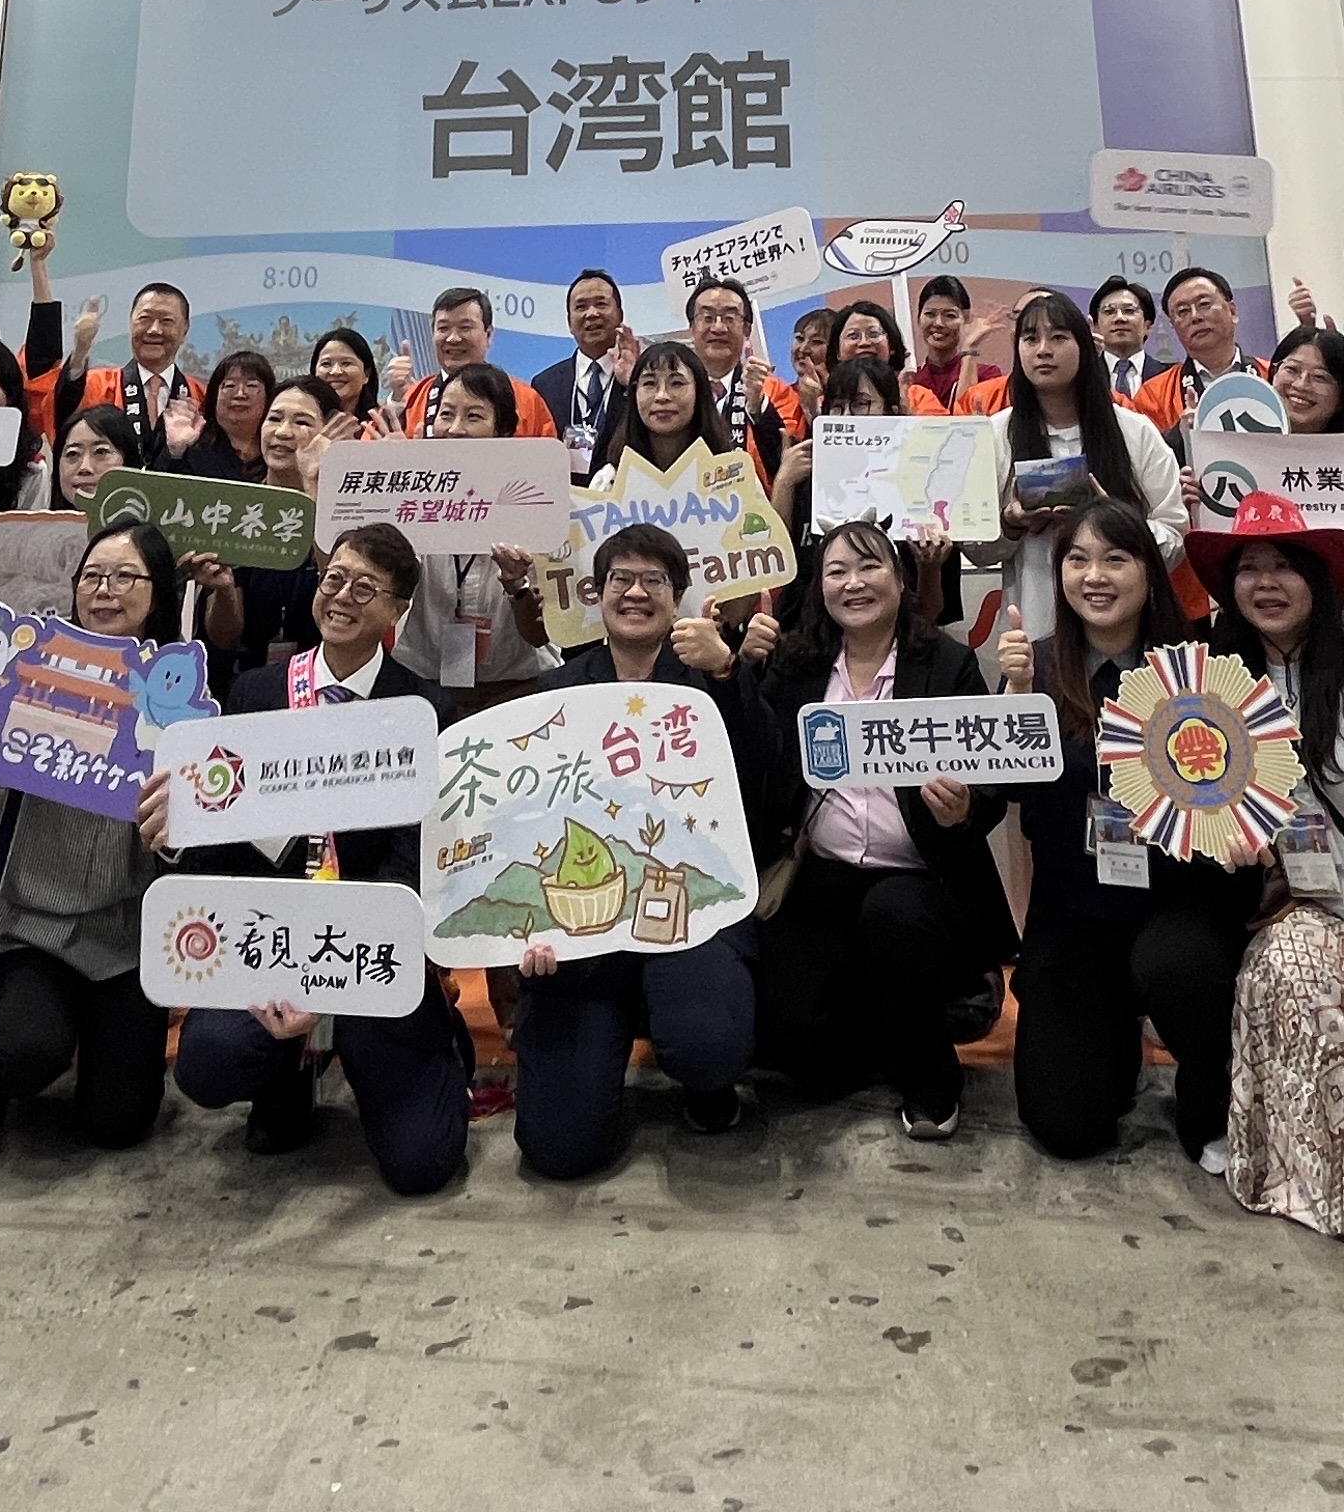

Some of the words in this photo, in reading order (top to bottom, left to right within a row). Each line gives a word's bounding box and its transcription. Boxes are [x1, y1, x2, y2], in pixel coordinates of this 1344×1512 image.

[422, 50, 792, 179] 台湾館
[1154, 168, 1216, 184] CHINA
[671, 224, 784, 271] チャイナエアラインで
[1116, 249, 1192, 275] 19:0
[262, 264, 319, 289] 8:00
[337, 469, 462, 494] 屏東縣政府
[394, 498, 493, 524] 希望城市
[570, 491, 740, 542] TAIWAN
[546, 567, 600, 611] Te
[861, 712, 1052, 756] 飛牛牧場
[438, 736, 604, 822] 茶の旅
[602, 703, 699, 778] 台湾
[862, 760, 930, 775] FLYING
[936, 758, 981, 772] COW
[987, 755, 1056, 771] RANCH
